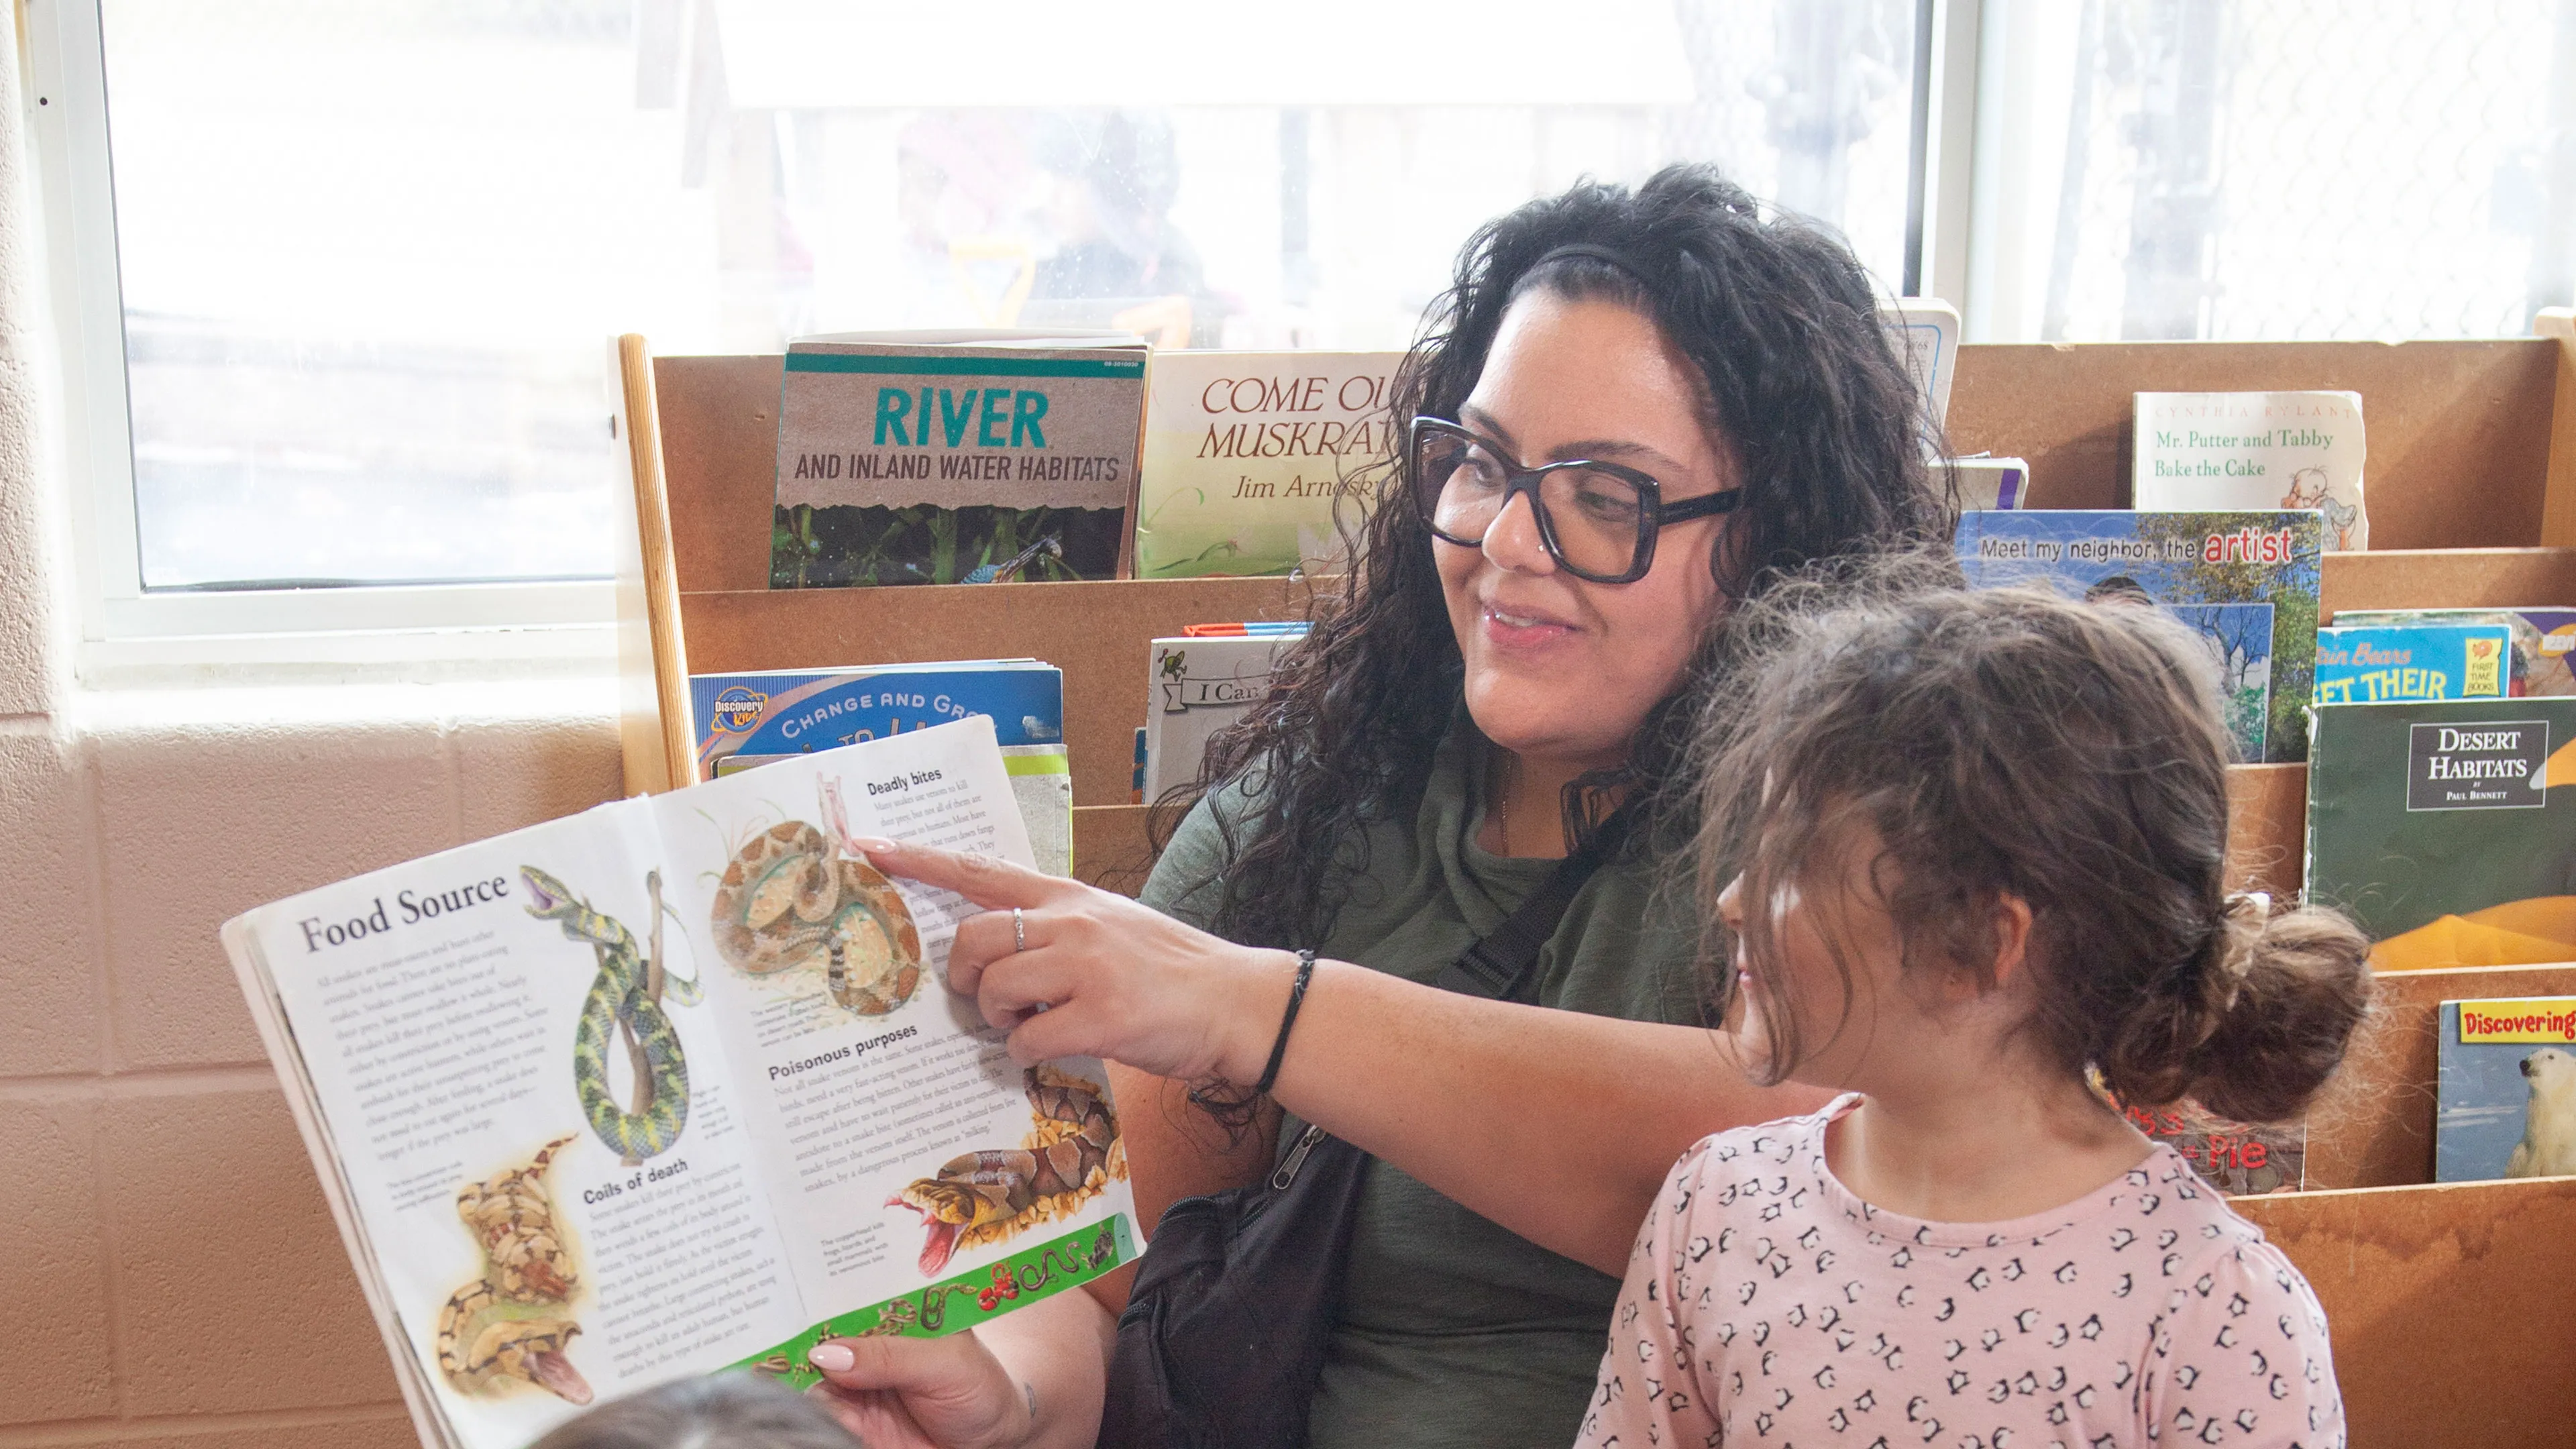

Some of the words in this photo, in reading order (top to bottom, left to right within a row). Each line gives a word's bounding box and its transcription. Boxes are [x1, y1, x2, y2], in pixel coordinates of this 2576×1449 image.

[1202, 376, 1328, 413] COME
[874, 387, 1049, 448] RIVER
[2155, 406, 2248, 417] CYNTHIA
[2265, 406, 2351, 419] RYLANT
[2157, 431, 2183, 448] Mr.
[2189, 431, 2238, 448] Putter
[2243, 431, 2272, 447] and
[2277, 429, 2334, 450] Tabby
[795, 454, 841, 479] AND
[849, 454, 930, 480] INLAND
[939, 455, 1010, 481] WATER
[1019, 456, 1119, 482] HABITATS
[2155, 460, 2192, 476] Bake
[2196, 460, 2220, 476] the
[2226, 459, 2265, 476] Cake
[1232, 476, 1275, 498] Jim
[1981, 539, 2027, 558] Meet
[2036, 542, 2061, 561] my
[2070, 539, 2157, 563] neighbor,
[2167, 539, 2195, 558] the
[2205, 528, 2293, 563] artist
[2352, 642, 2412, 665] Bears
[2471, 673, 2491, 681] TIME
[2472, 662, 2494, 671] FIRST
[1199, 684, 1210, 701] I
[2361, 669, 2447, 702] THEIR
[2467, 683, 2495, 692] BOOKS
[715, 701, 763, 713] Discovery
[782, 694, 872, 739] CHANGE
[880, 693, 925, 708] AND
[933, 694, 983, 722] GRO
[2437, 729, 2521, 751] DESERT
[2428, 756, 2527, 780] HABITATS
[867, 776, 908, 796] Deadly
[910, 767, 942, 786] bites
[2446, 791, 2467, 800] PAUL
[2470, 791, 2508, 800] BENNETT
[298, 898, 391, 953] Food
[396, 875, 509, 924] Source
[2464, 1012, 2576, 1040] Discovering
[768, 1047, 851, 1081] Poisonous
[854, 1024, 918, 1059] purposes
[2208, 1134, 2267, 1169] Pie
[584, 1183, 622, 1205] Coils
[627, 1169, 642, 1190] of
[647, 1159, 689, 1183] death
